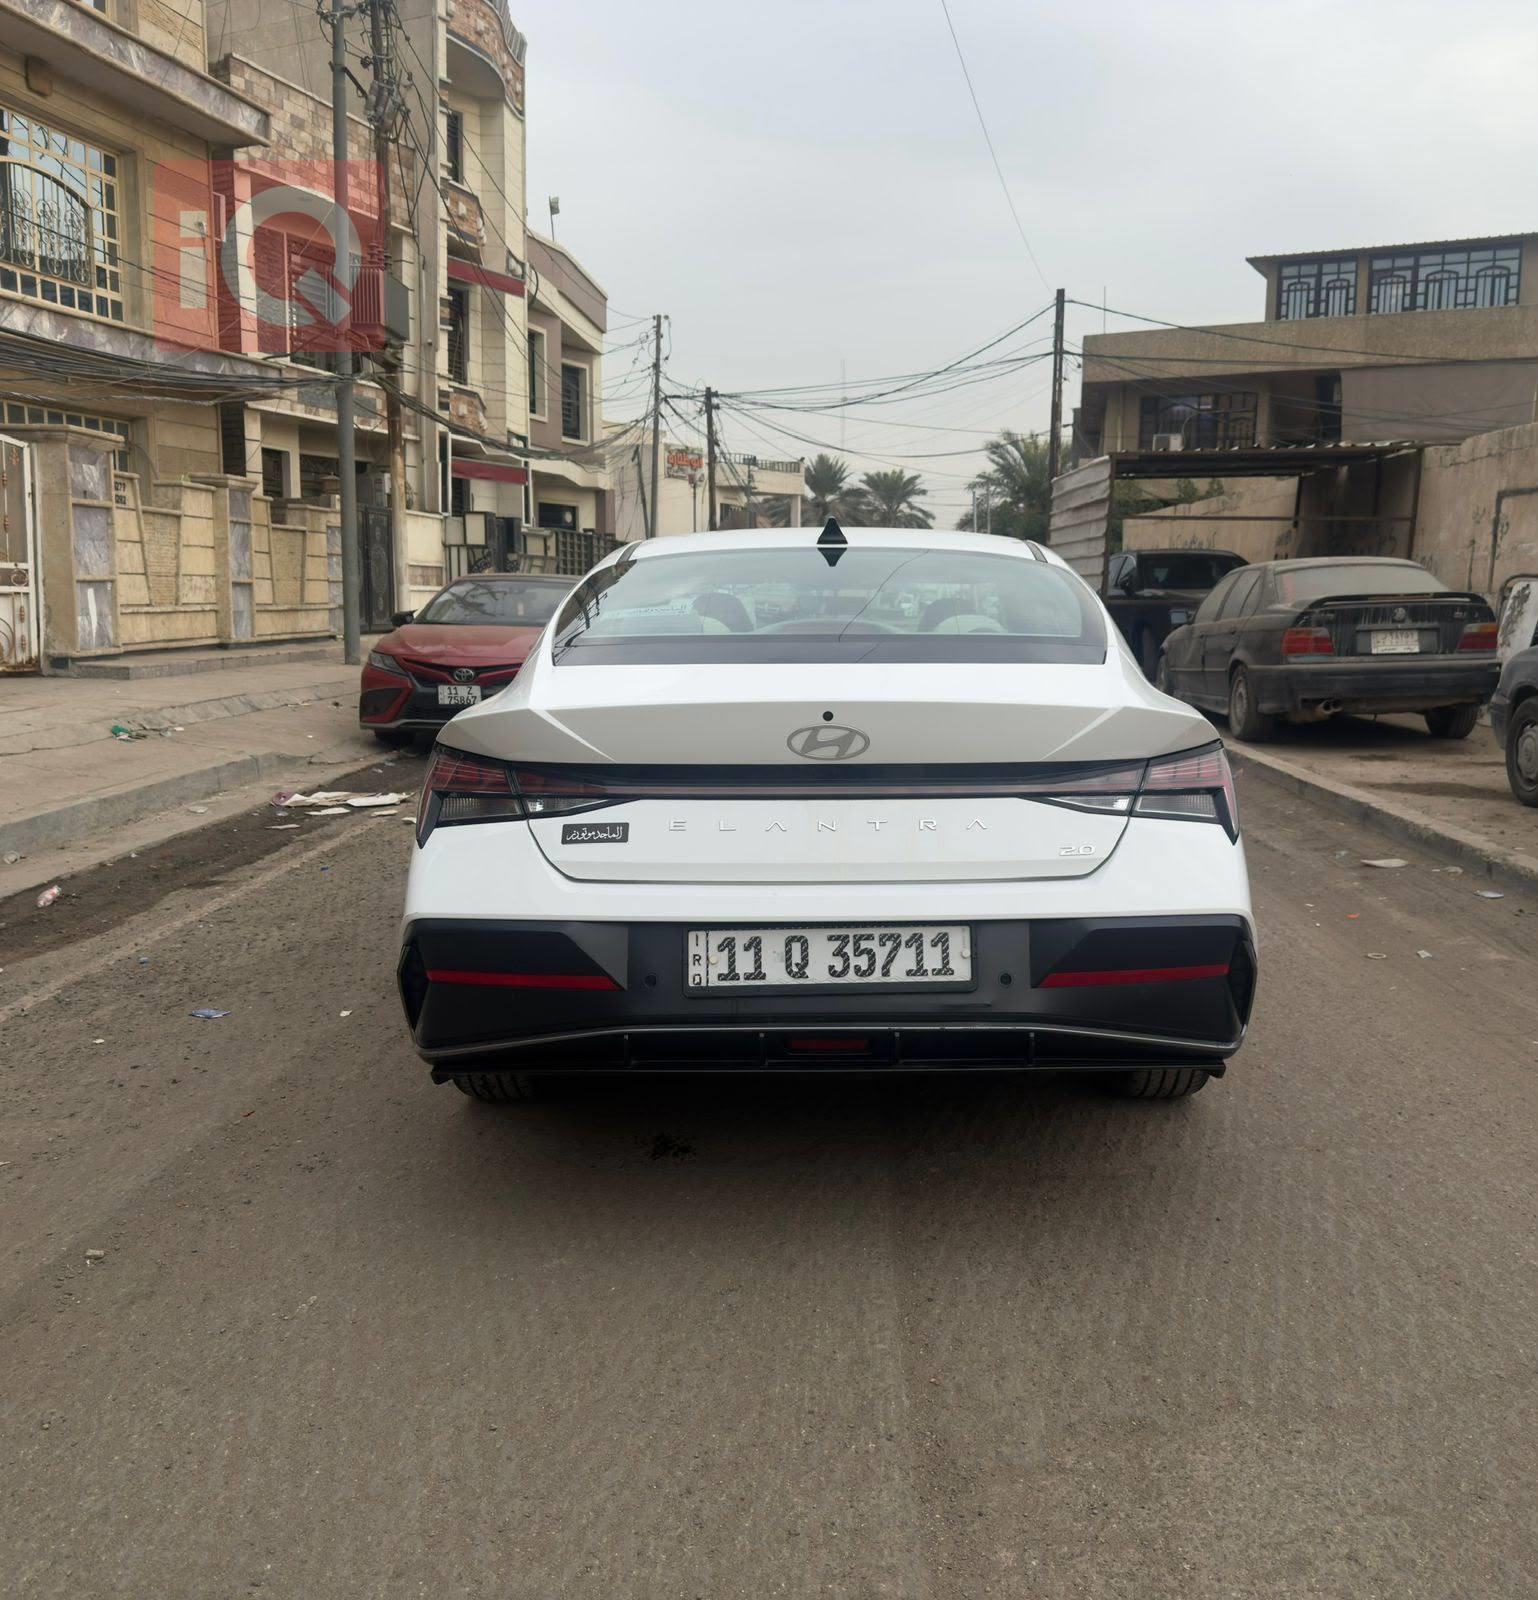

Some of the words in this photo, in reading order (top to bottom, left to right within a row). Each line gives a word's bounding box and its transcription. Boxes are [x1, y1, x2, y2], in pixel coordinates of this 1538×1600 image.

[447, 686, 458, 695] 11
[467, 685, 473, 695] Z
[668, 816, 988, 832] ELANTRA
[717, 935, 767, 982] 11
[784, 934, 809, 979] Q
[826, 931, 955, 978] 35711
